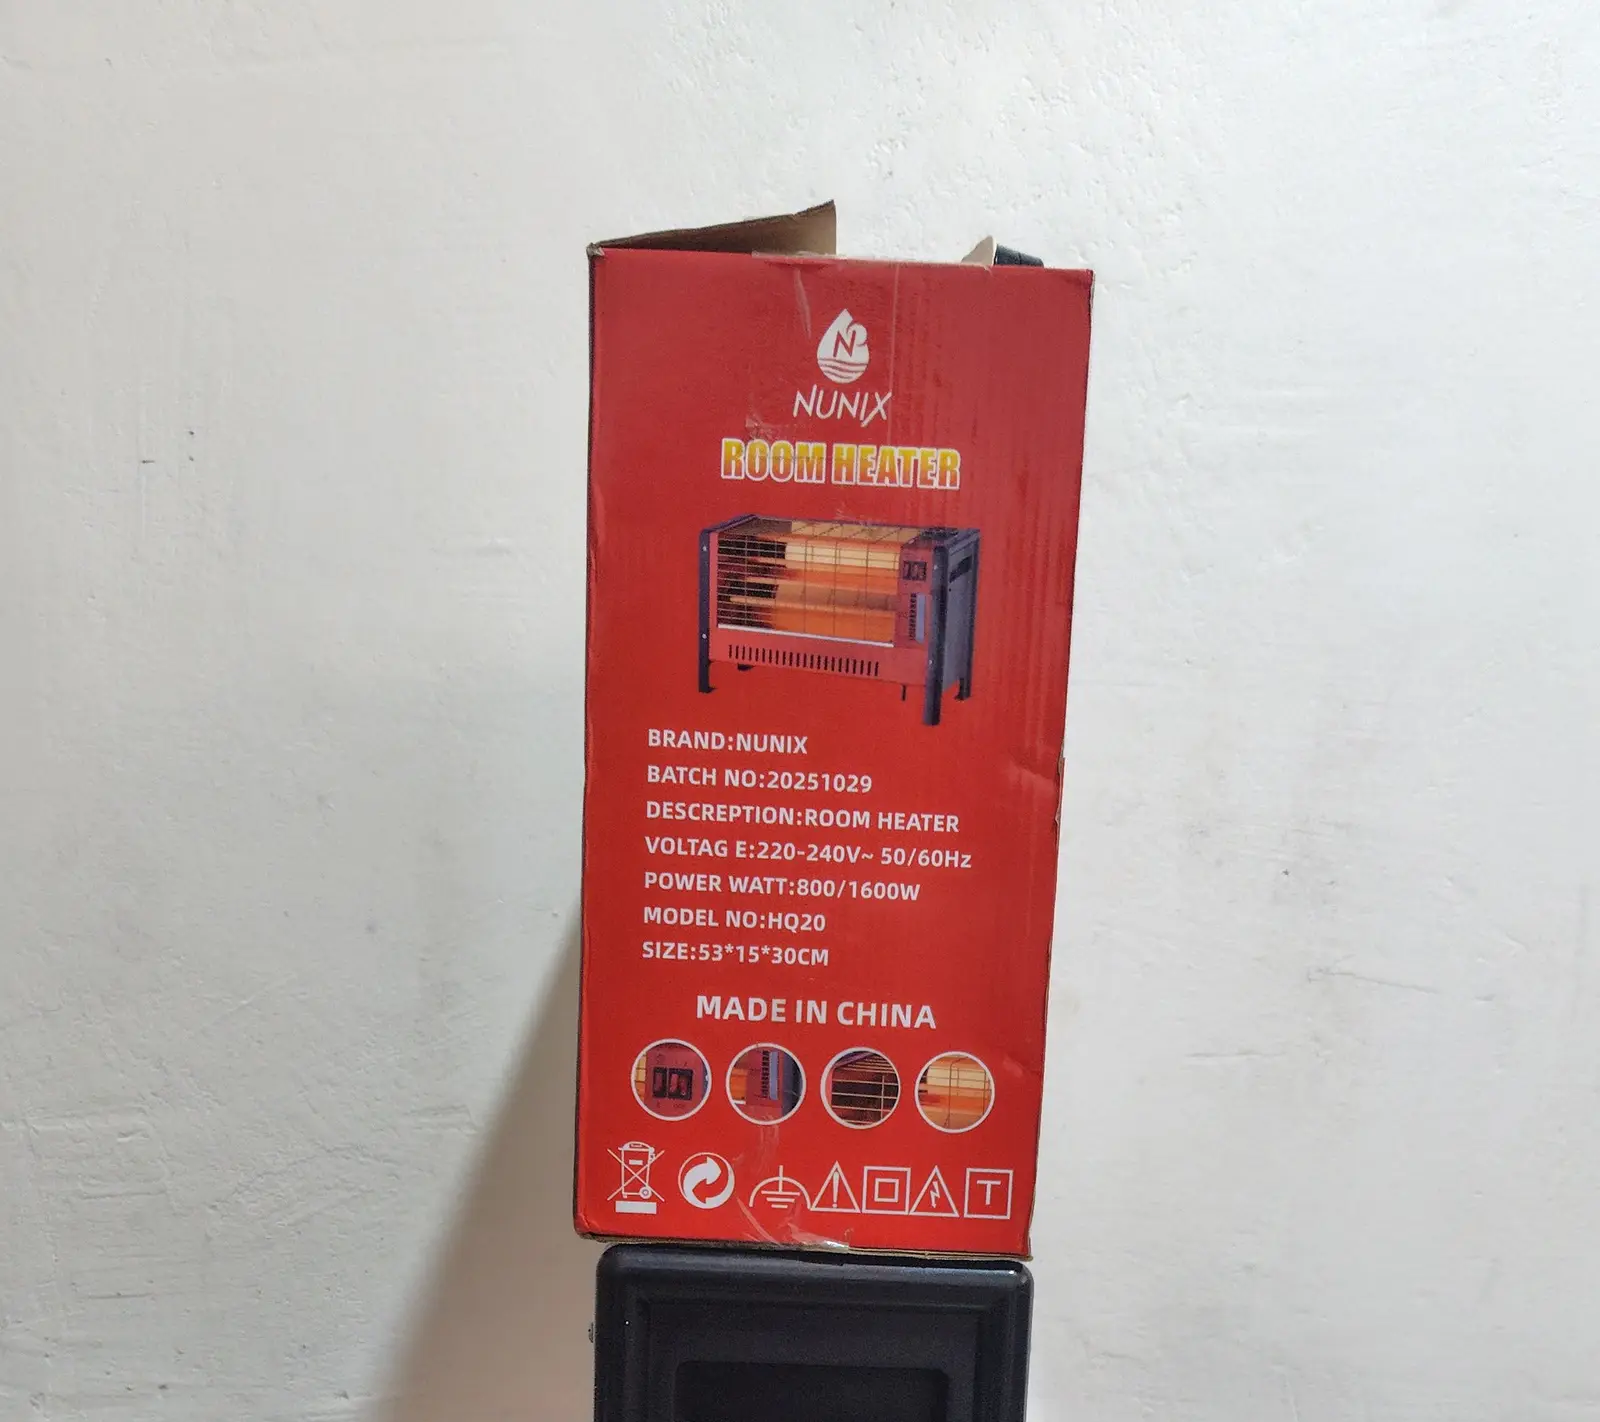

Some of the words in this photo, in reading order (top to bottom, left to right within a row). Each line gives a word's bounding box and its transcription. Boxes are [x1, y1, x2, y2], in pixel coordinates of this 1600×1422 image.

[793, 385, 892, 427] NUNIX
[721, 438, 826, 484] ROOM
[832, 444, 961, 490] HEATER
[648, 729, 808, 754] BRAND:NUNIX
[647, 765, 717, 787] BATCH
[724, 768, 873, 793] NO:20251029
[646, 801, 871, 829] DESCREPTION:ROOM
[878, 812, 960, 833] HEATER
[645, 836, 728, 858] VOLTAG
[736, 839, 874, 863] E:220-240V~
[880, 845, 972, 869] 50/60Hz
[644, 872, 722, 893] POWER
[729, 876, 921, 901] WATT:800/1600W
[643, 906, 719, 929] MODEL
[726, 910, 826, 934] NO:HQ20
[696, 995, 787, 1023] MADE
[796, 1000, 828, 1024] IN
[837, 1001, 937, 1030] CHINA
